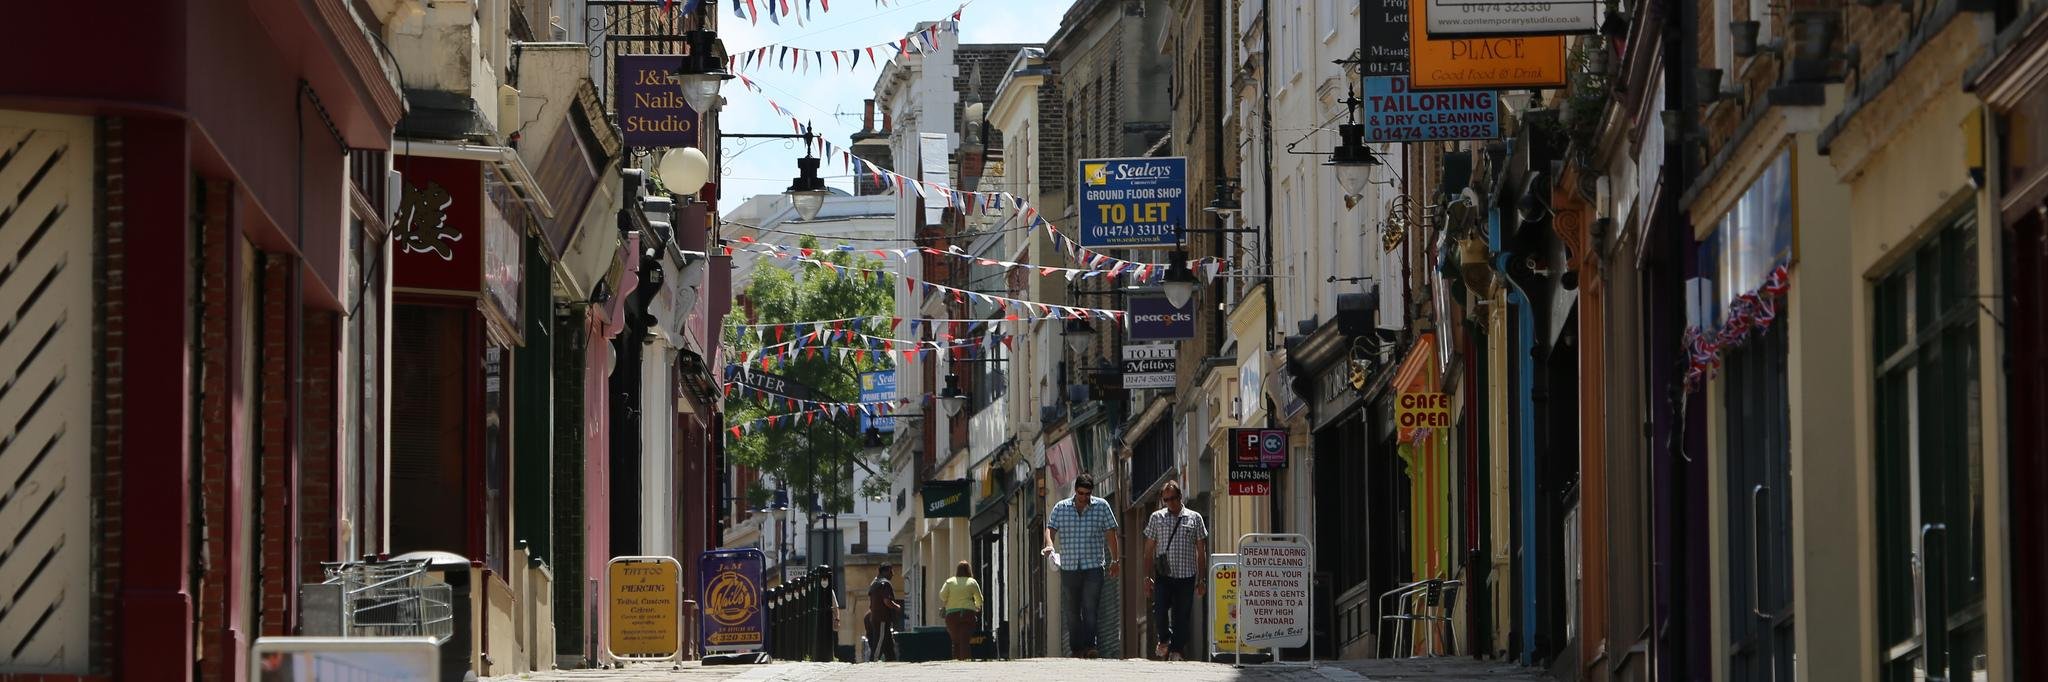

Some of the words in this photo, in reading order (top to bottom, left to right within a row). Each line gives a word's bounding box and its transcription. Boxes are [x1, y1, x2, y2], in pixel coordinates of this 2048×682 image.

[1383, 0, 1408, 9] Prop
[1385, 13, 1408, 23] Lett
[1438, 16, 1582, 26] www.contemporarystudio.co.uk
[1371, 46, 1409, 57] Manag
[1451, 38, 1525, 60] PLACE
[634, 91, 684, 109] Nails
[1370, 92, 1492, 112] TAILORING
[627, 115, 691, 132] Studio
[1370, 115, 1380, 126] &
[1385, 114, 1415, 125] DRY
[1420, 112, 1495, 124] CLEANING
[1372, 127, 1422, 140] 01474
[1428, 124, 1492, 138] 333825
[1115, 162, 1172, 180] Sealeys
[1086, 190, 1124, 201] GROUND
[1126, 189, 1156, 199] FLOOR
[1157, 187, 1182, 198] SHOP
[1098, 203, 1126, 224] TO
[1133, 202, 1171, 223] LET
[1092, 225, 1134, 238] (01474)
[1134, 313, 1191, 327] peacocks
[1129, 349, 1146, 360] TO
[1149, 349, 1175, 358] LET
[1127, 360, 1174, 372] Maltbys
[726, 369, 785, 393] ARTER
[878, 373, 896, 385] Seal
[1401, 394, 1448, 410] CAFE
[1400, 412, 1449, 427] OPEN
[1231, 471, 1251, 479] 01474
[1252, 471, 1270, 479] 3646
[1239, 484, 1254, 493] Let
[1257, 484, 1269, 494] By
[929, 492, 963, 512] SUBWAY
[1244, 548, 1269, 556] DREAM
[1270, 548, 1306, 556] TAILORING
[1246, 558, 1252, 566] &
[1268, 558, 1303, 566] CLEANING
[624, 567, 663, 575] TATTOO
[621, 584, 665, 593] PIERCING
[713, 580, 746, 615] Nails
[1246, 631, 1272, 641] Simply
[1274, 628, 1284, 636] the
[1287, 627, 1304, 635] Best
